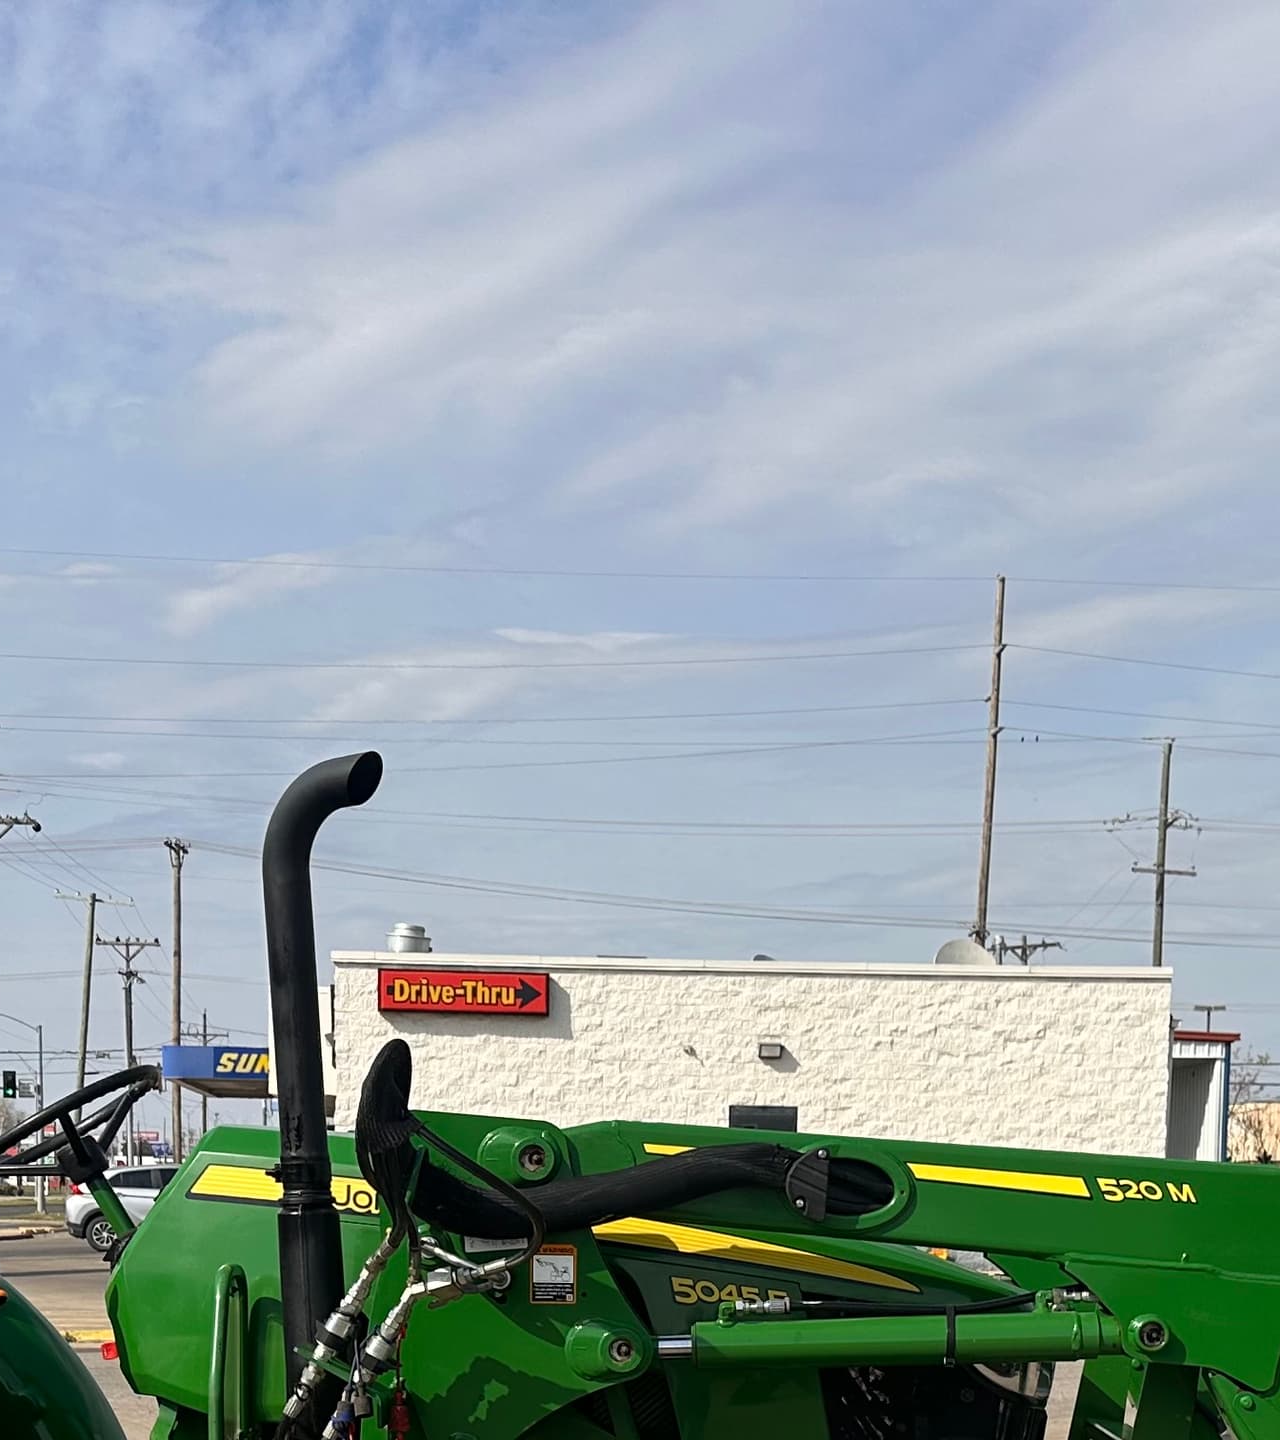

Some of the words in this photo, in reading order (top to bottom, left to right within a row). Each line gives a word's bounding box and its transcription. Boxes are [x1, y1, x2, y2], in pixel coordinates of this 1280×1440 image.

[394, 979, 516, 1006] Drive-Thru
[1096, 1177, 1163, 1203] 520
[1165, 1182, 1198, 1204] M
